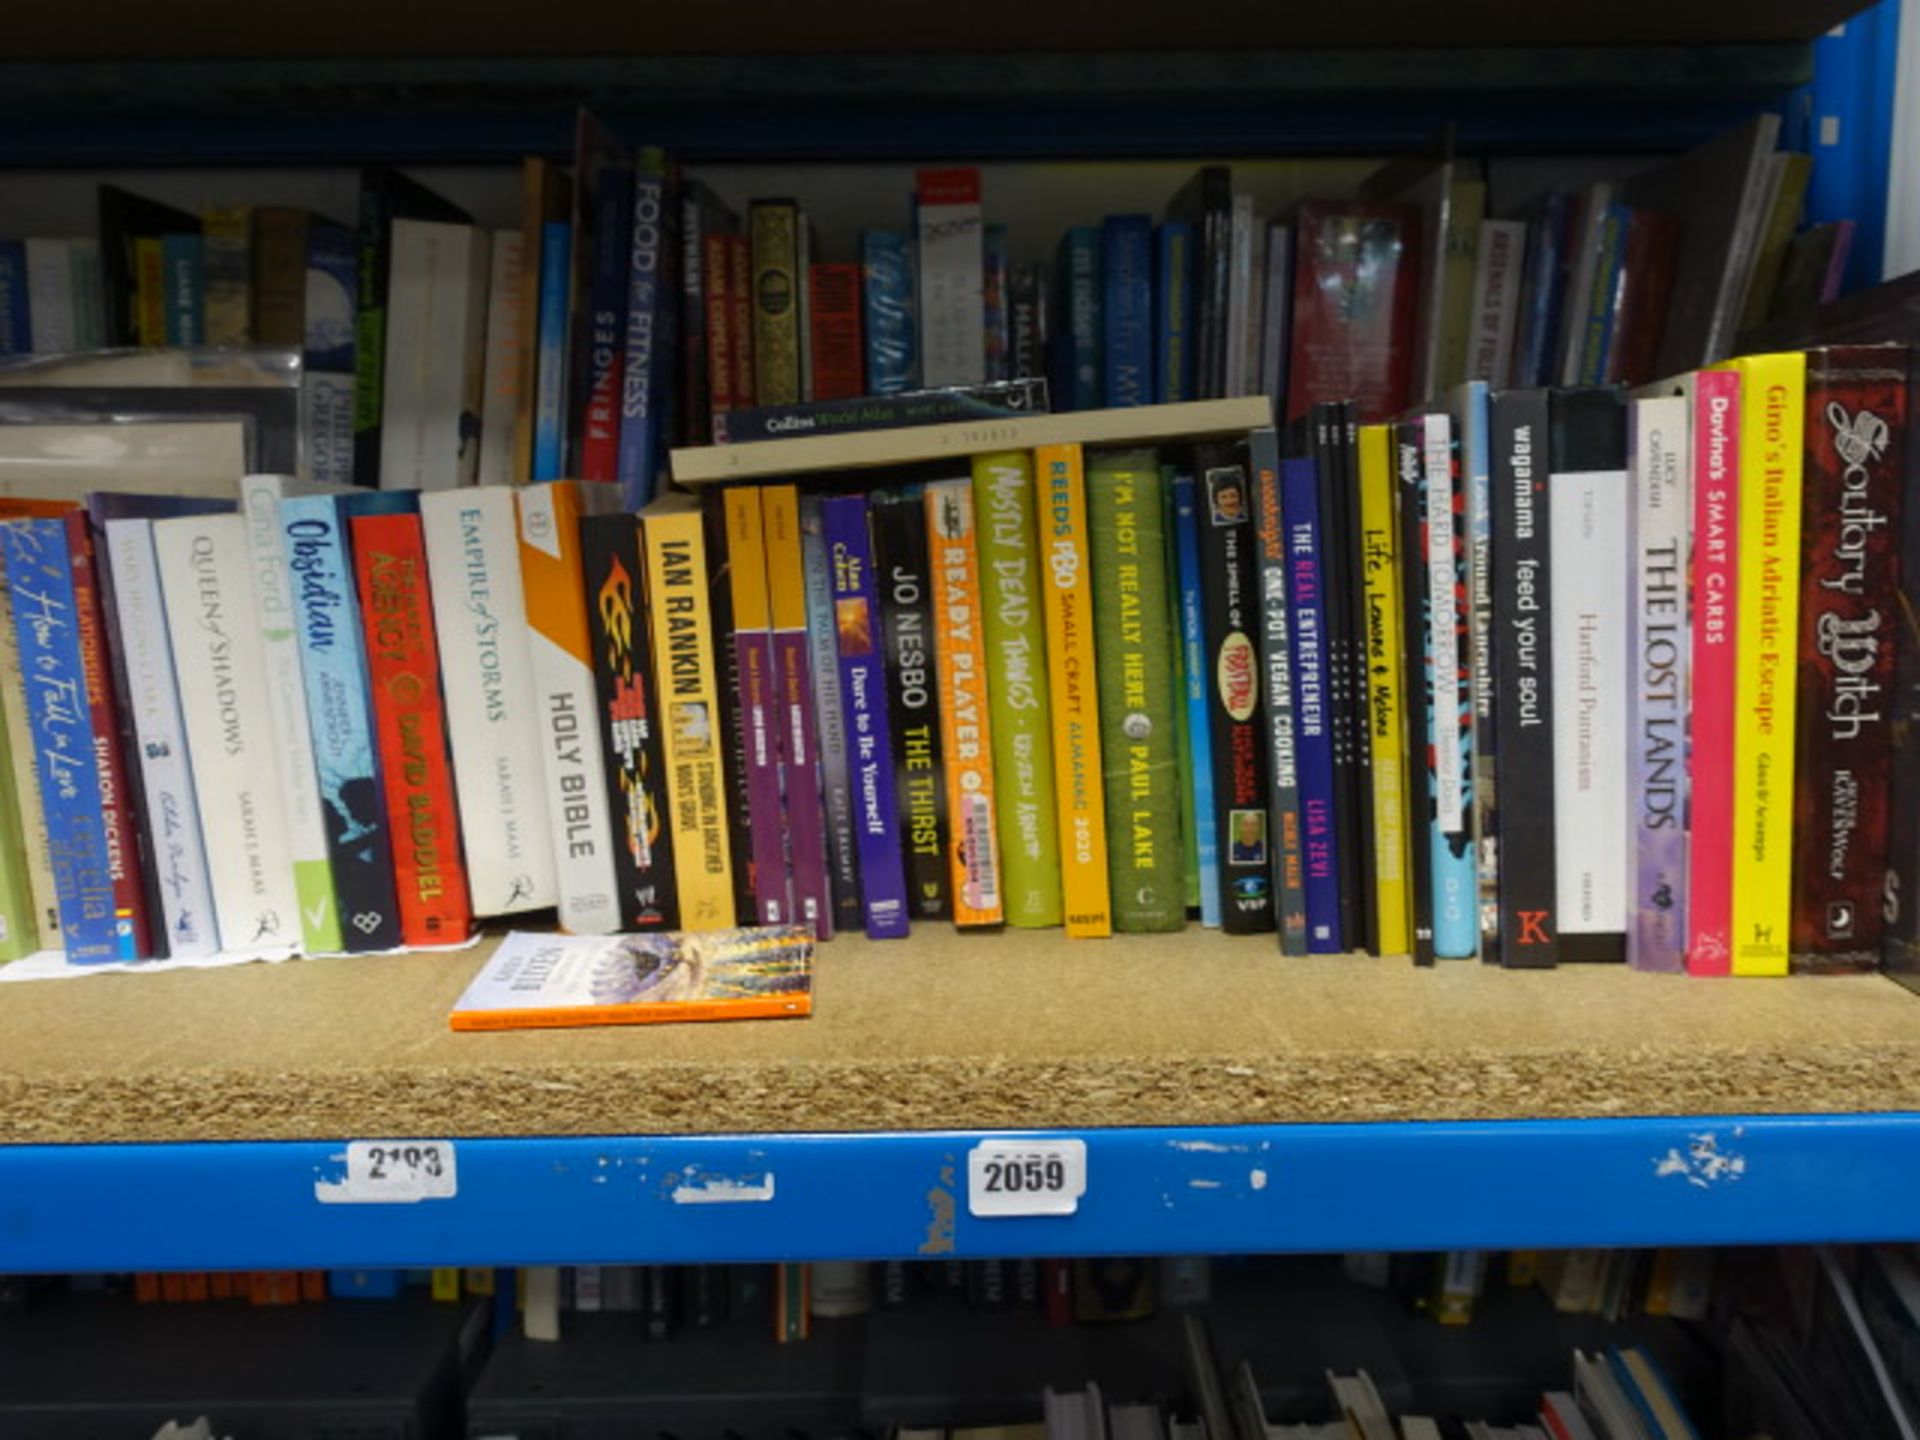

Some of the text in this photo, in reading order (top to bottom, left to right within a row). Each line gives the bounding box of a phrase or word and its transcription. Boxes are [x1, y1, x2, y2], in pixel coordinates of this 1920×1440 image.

[631, 182, 662, 272] FOOD
[589, 309, 616, 441] FRINGES
[623, 312, 652, 419] FITNESS
[312, 380, 332, 481] GREGOR
[333, 388, 349, 484] PHILIPP
[1648, 429, 1664, 509] CAVENDISH
[1663, 452, 1678, 487] LUCY
[1051, 461, 1072, 537] REEDS
[1226, 530, 1238, 558] THE
[1705, 396, 1731, 646] Davina's SMART CARBS
[250, 487, 284, 613] Gina Ford
[287, 519, 341, 654] Obsidian
[832, 542, 848, 592] Cohen
[848, 556, 863, 591] Alan
[945, 547, 971, 642] READY
[988, 466, 1039, 711] MOSTLY DEAD THINGS
[1112, 472, 1147, 710] I'M NOT REALLY HERE
[1226, 561, 1241, 607] SMELL
[1364, 530, 1394, 587] Life,
[1427, 439, 1456, 696] THE HARD TOMORROW
[1474, 532, 1491, 605] Around
[1510, 425, 1542, 728] wagamama feed your soul
[1753, 384, 1789, 736] Gino's Italian Adriatic Escape
[1817, 401, 1890, 741] Solitary Witch
[190, 535, 222, 619] QUEEN
[208, 640, 244, 756] SHADOWS
[368, 551, 408, 662] AGENCY
[459, 508, 490, 601] EMPIRE
[475, 620, 508, 723] STORMS
[660, 541, 703, 696] IAN RANKIN
[892, 566, 929, 709] JO NESBO
[1060, 593, 1079, 653] SMALL
[1263, 566, 1288, 642] ONE-POT
[1292, 522, 1323, 737] THE REAL ENTREPRENEUR
[1578, 612, 1598, 691] Hartford
[34, 674, 84, 732] Fall
[952, 653, 980, 760] PLAYER
[1063, 657, 1082, 715] CRAFT
[1267, 648, 1292, 707] VEGAN
[1475, 610, 1495, 718] Lancashire
[1644, 537, 1679, 831] THE LOST LANDS
[93, 736, 116, 805] SHARON
[550, 692, 584, 766] HOLY
[851, 667, 886, 836] Dare to Be Yourself
[1067, 721, 1088, 810] ALMANAC
[1273, 715, 1297, 789] COOKING
[400, 713, 444, 904] DAVID BADDIEL
[560, 773, 596, 859] BIBLE
[904, 726, 940, 856] THE THIRST
[1129, 745, 1155, 869] PAUL LAKE
[1074, 816, 1093, 864] 2020
[1306, 800, 1331, 878] LISA ZEVI
[1516, 910, 1551, 944] K
[983, 1161, 1064, 1193] 2059
